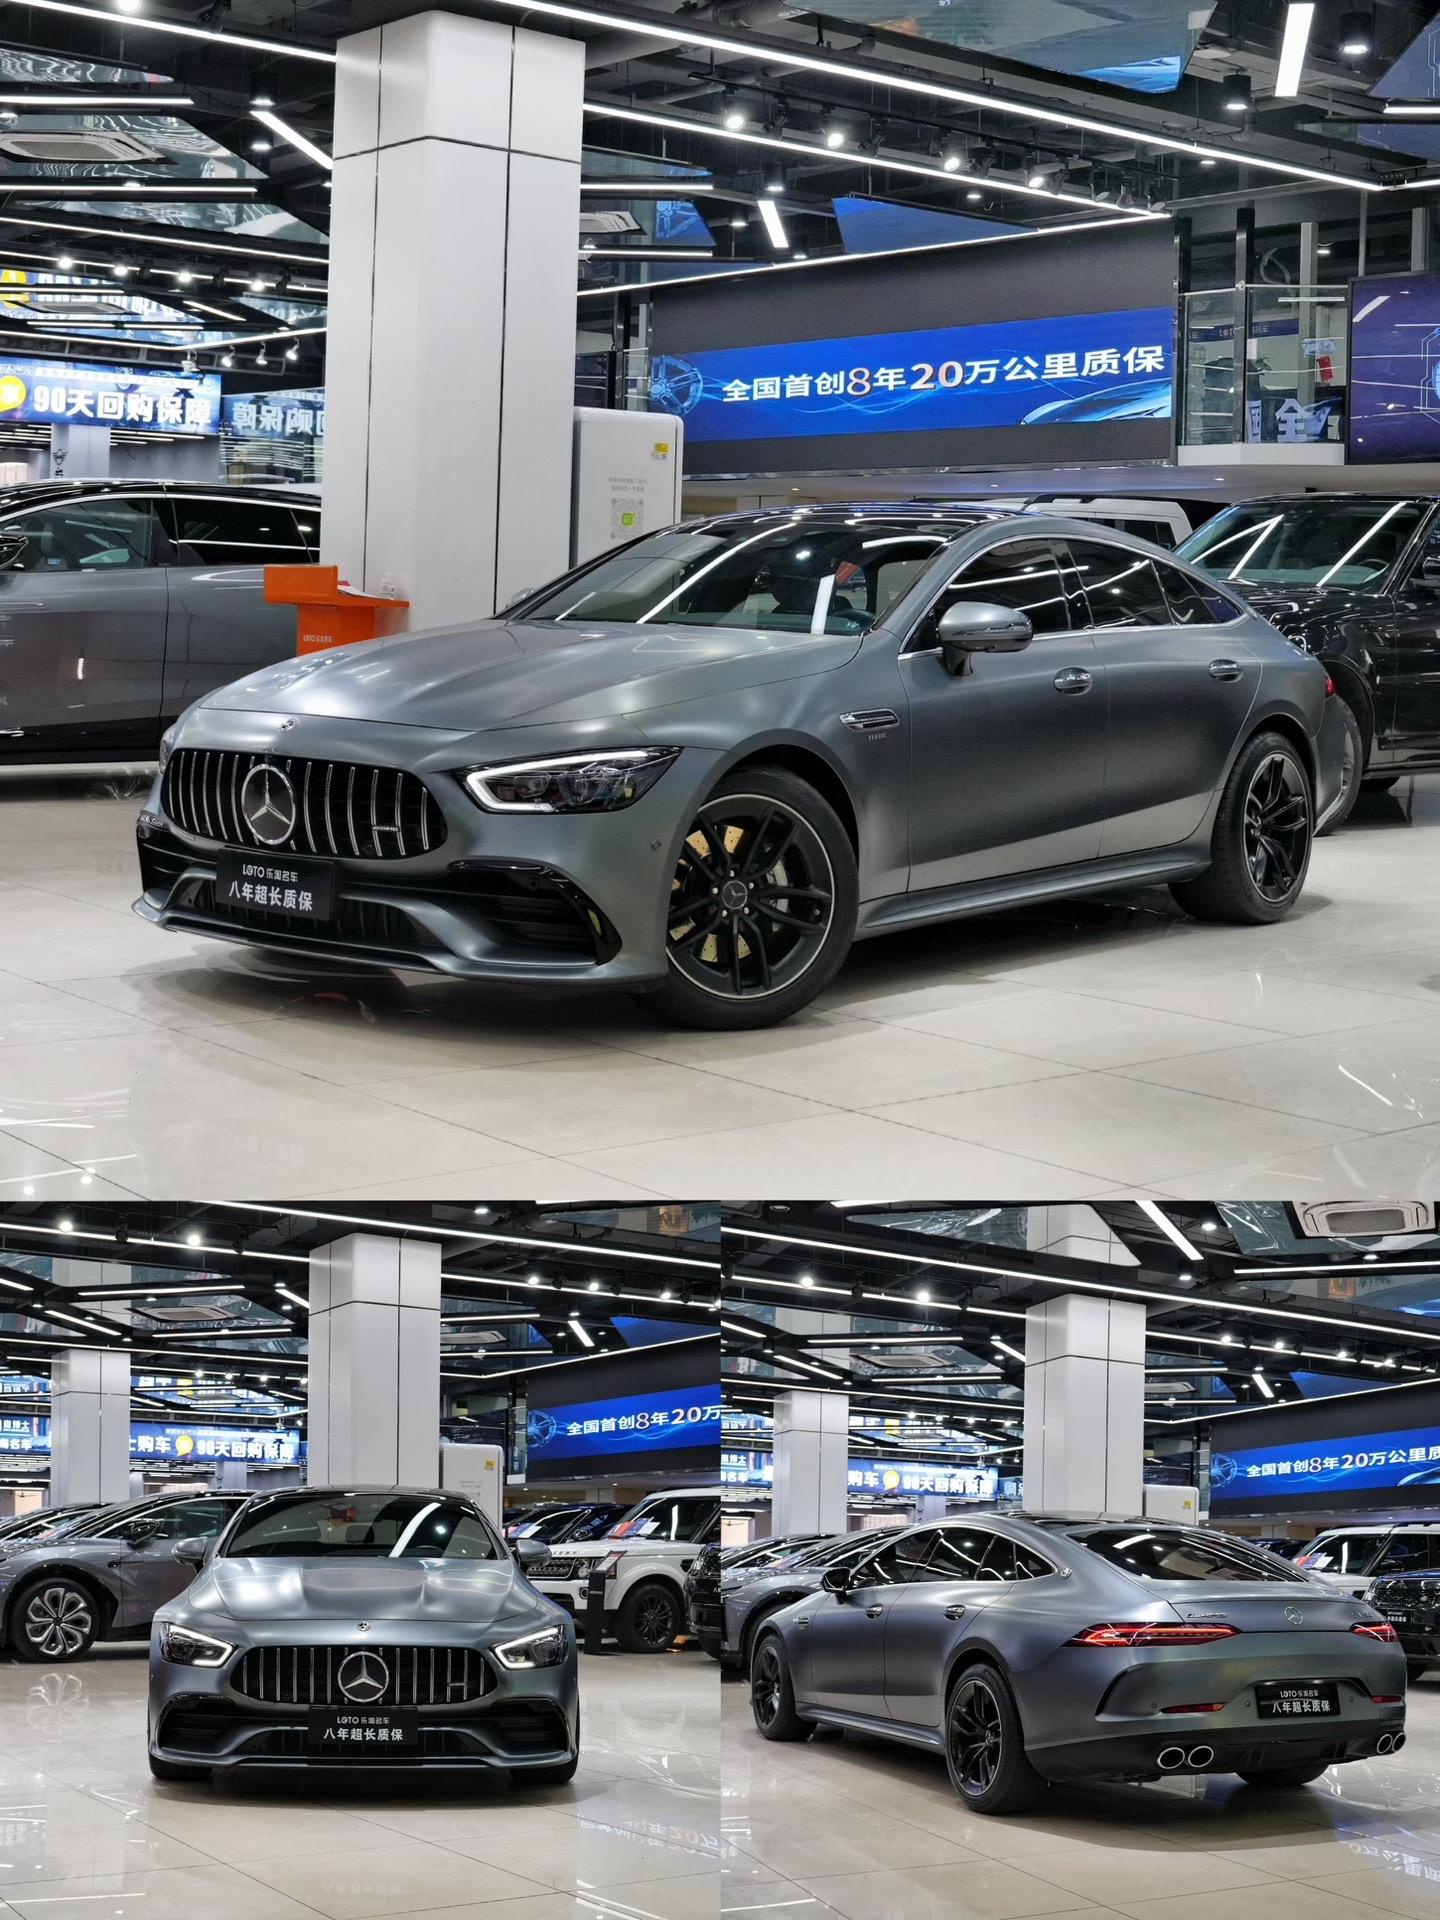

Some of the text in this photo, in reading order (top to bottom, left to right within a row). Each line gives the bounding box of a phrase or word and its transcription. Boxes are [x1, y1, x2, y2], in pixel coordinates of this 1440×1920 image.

[722, 345, 1165, 403] 全国首创8年20万公里质保
[34, 385, 211, 426] 90天回购保障
[242, 864, 265, 878] LOTO
[229, 880, 313, 911] 八年超长质保
[1280, 1690, 1298, 1698] LOTO
[1272, 1700, 1331, 1714] 八年超长质保
[337, 1716, 360, 1725] LOTO
[323, 1727, 404, 1741] 八年超长质保
